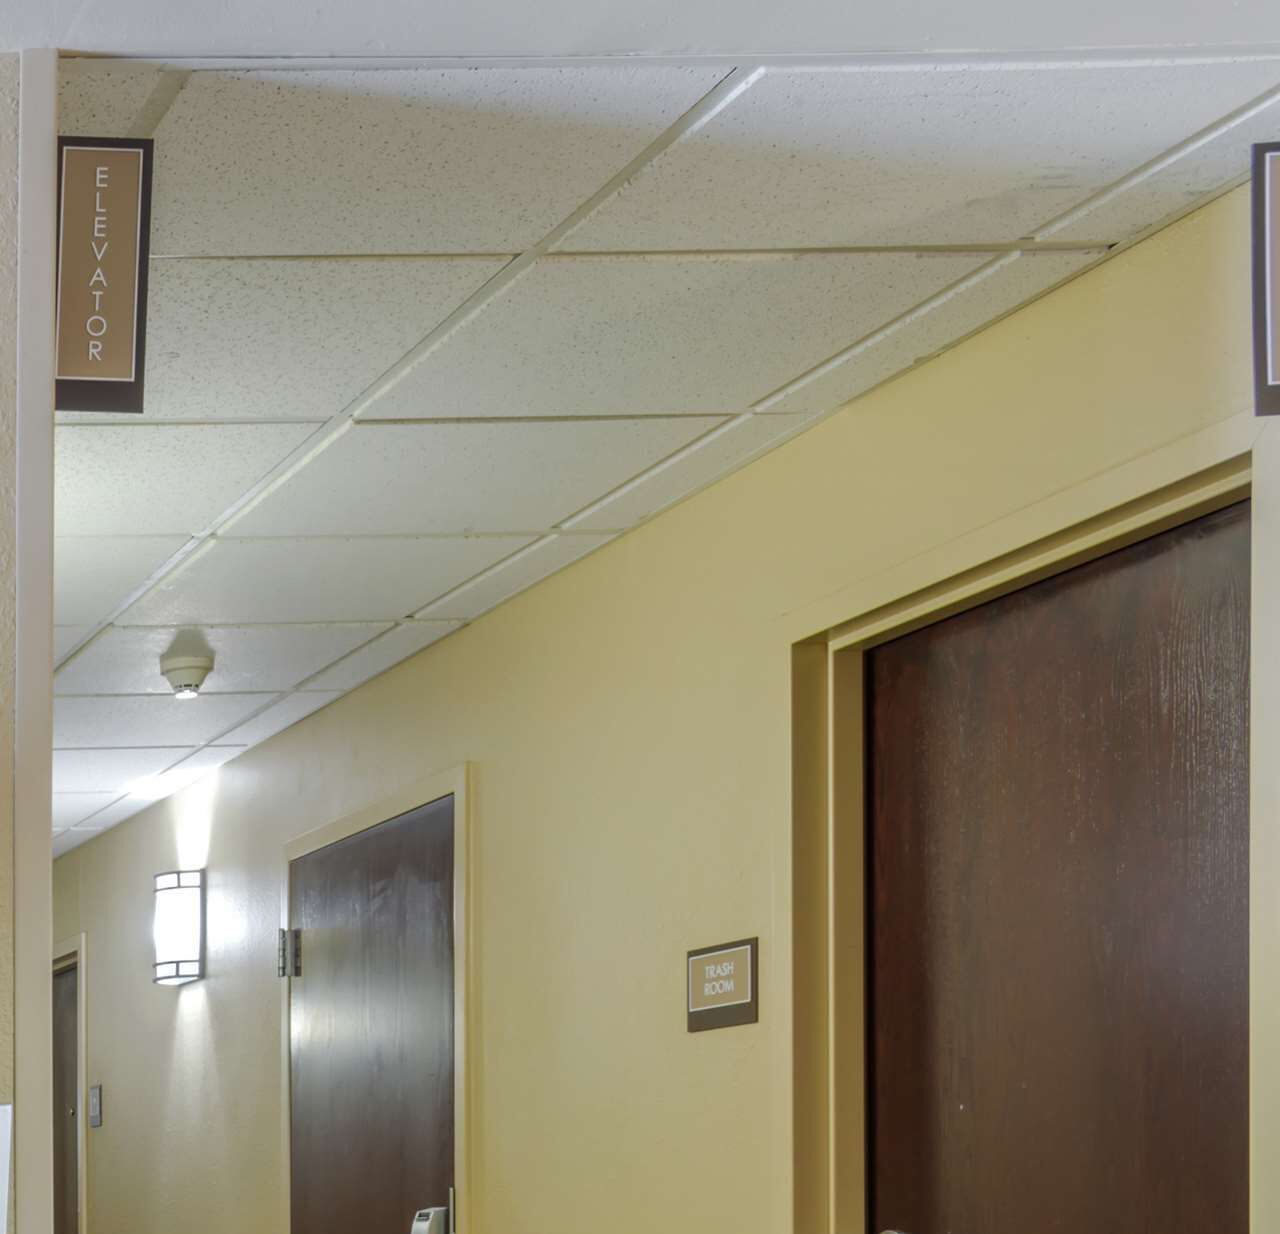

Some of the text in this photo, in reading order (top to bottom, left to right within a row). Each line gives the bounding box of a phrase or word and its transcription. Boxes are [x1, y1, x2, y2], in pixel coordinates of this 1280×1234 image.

[85, 166, 109, 361] ELEVATOR
[704, 961, 734, 978] TRASH
[704, 979, 734, 996] ROOM
